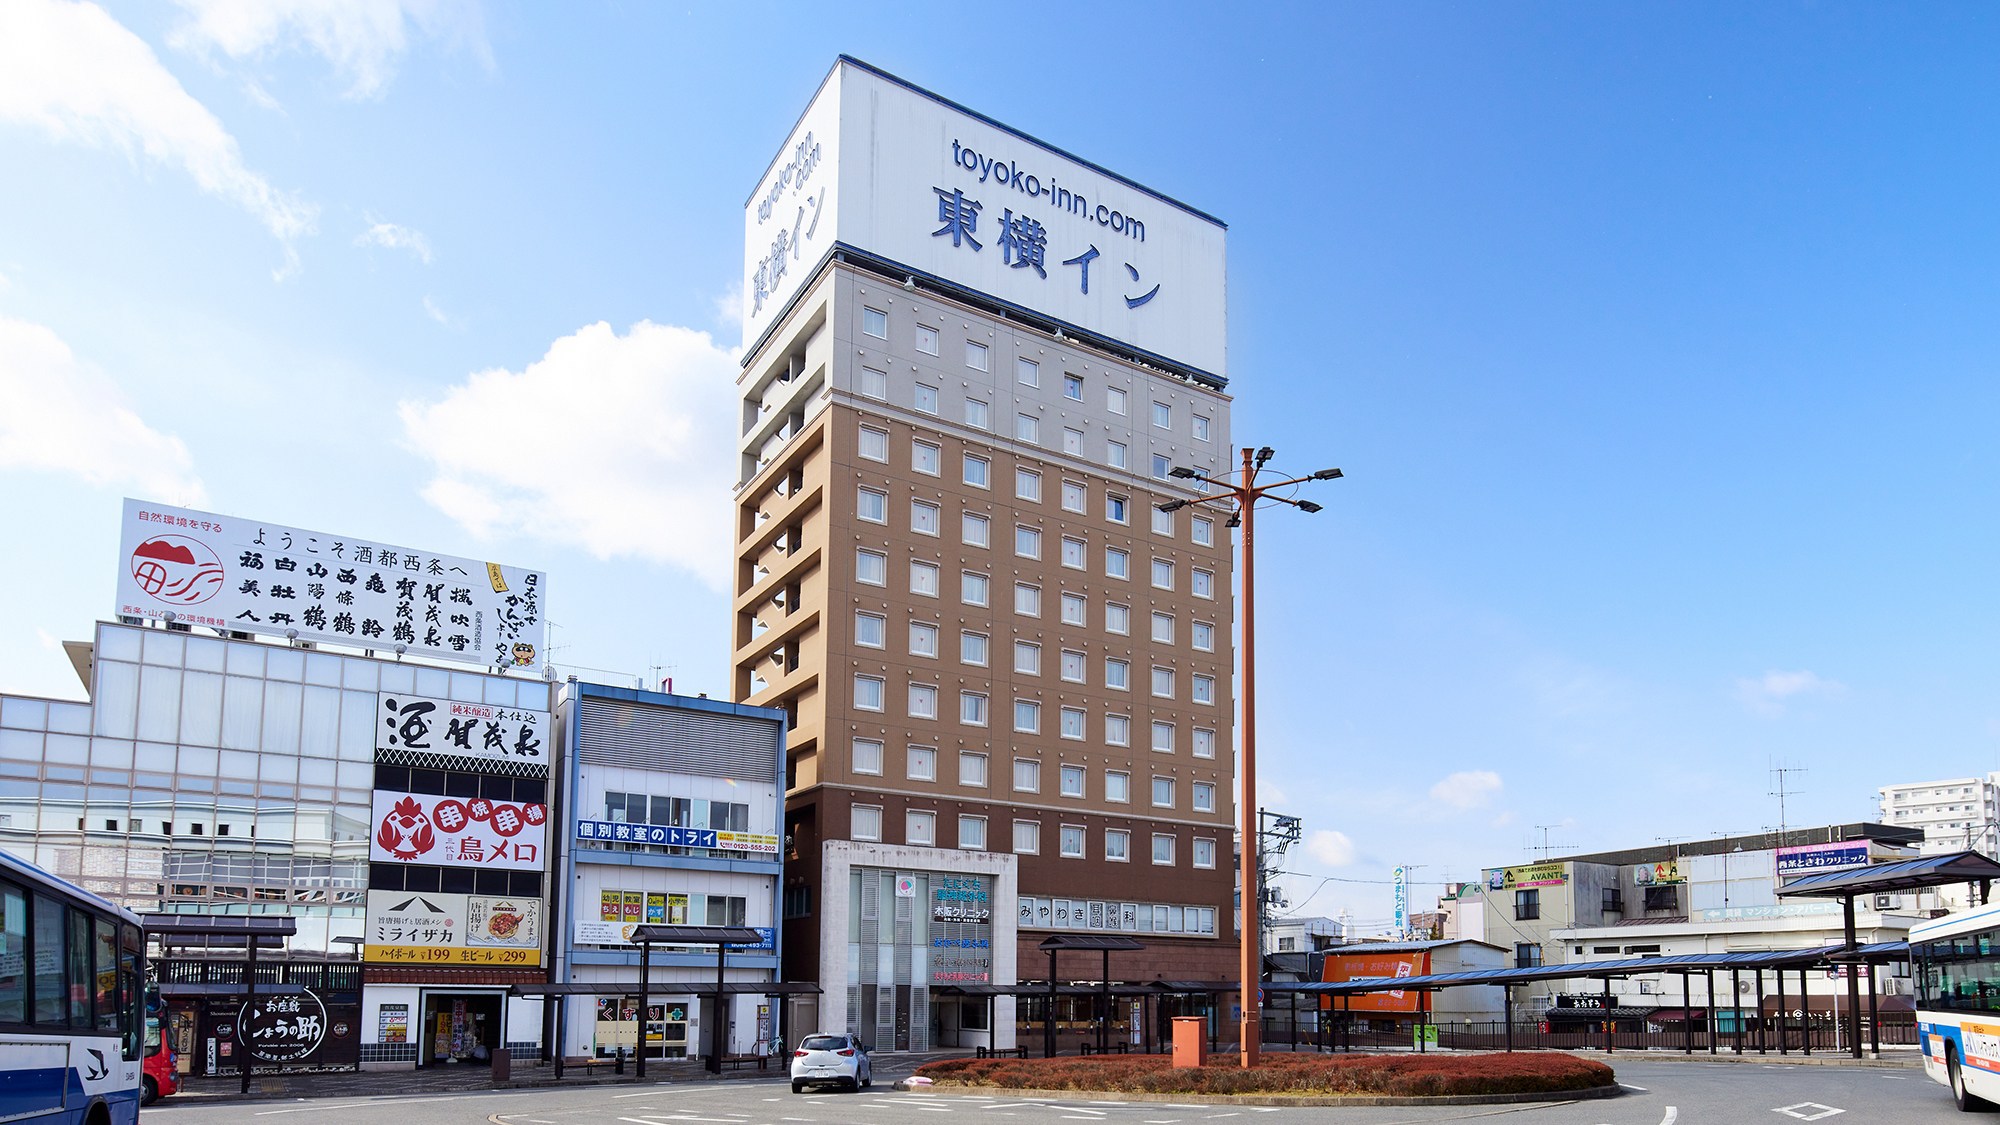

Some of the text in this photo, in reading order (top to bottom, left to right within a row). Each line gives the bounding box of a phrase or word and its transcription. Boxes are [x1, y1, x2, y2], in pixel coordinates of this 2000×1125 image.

[758, 130, 814, 226] toyoko-inn
[951, 138, 1146, 242] toyoko-inn.com
[752, 186, 826, 318] 東横イン
[932, 186, 1161, 309] 東横イン
[138, 510, 223, 533] 自然環境を守る
[252, 527, 469, 577] ようこそ酒都西条へ
[268, 556, 298, 626] 白牡丹
[302, 562, 329, 632] 山陽鶴
[523, 573, 539, 626] 日本酒で
[122, 604, 225, 626] 西条・山との環境機構
[392, 577, 418, 645] 賀茂鶴
[422, 583, 446, 647] 賀茂泉
[505, 594, 526, 641] かんぱい
[451, 703, 493, 719] 純米醸造
[494, 708, 538, 725] 本仕込
[444, 718, 542, 757] 賀茂泉
[457, 836, 538, 864] 鳥メロ
[579, 821, 716, 846] 個別教室のトライ
[733, 842, 776, 852] 0120-555-202
[602, 905, 664, 916] ちえ もじ かず
[377, 926, 454, 943] ミライザカ
[379, 948, 416, 959] ハイボール
[460, 950, 495, 962] 生ビール
[602, 1007, 660, 1021] くすり
